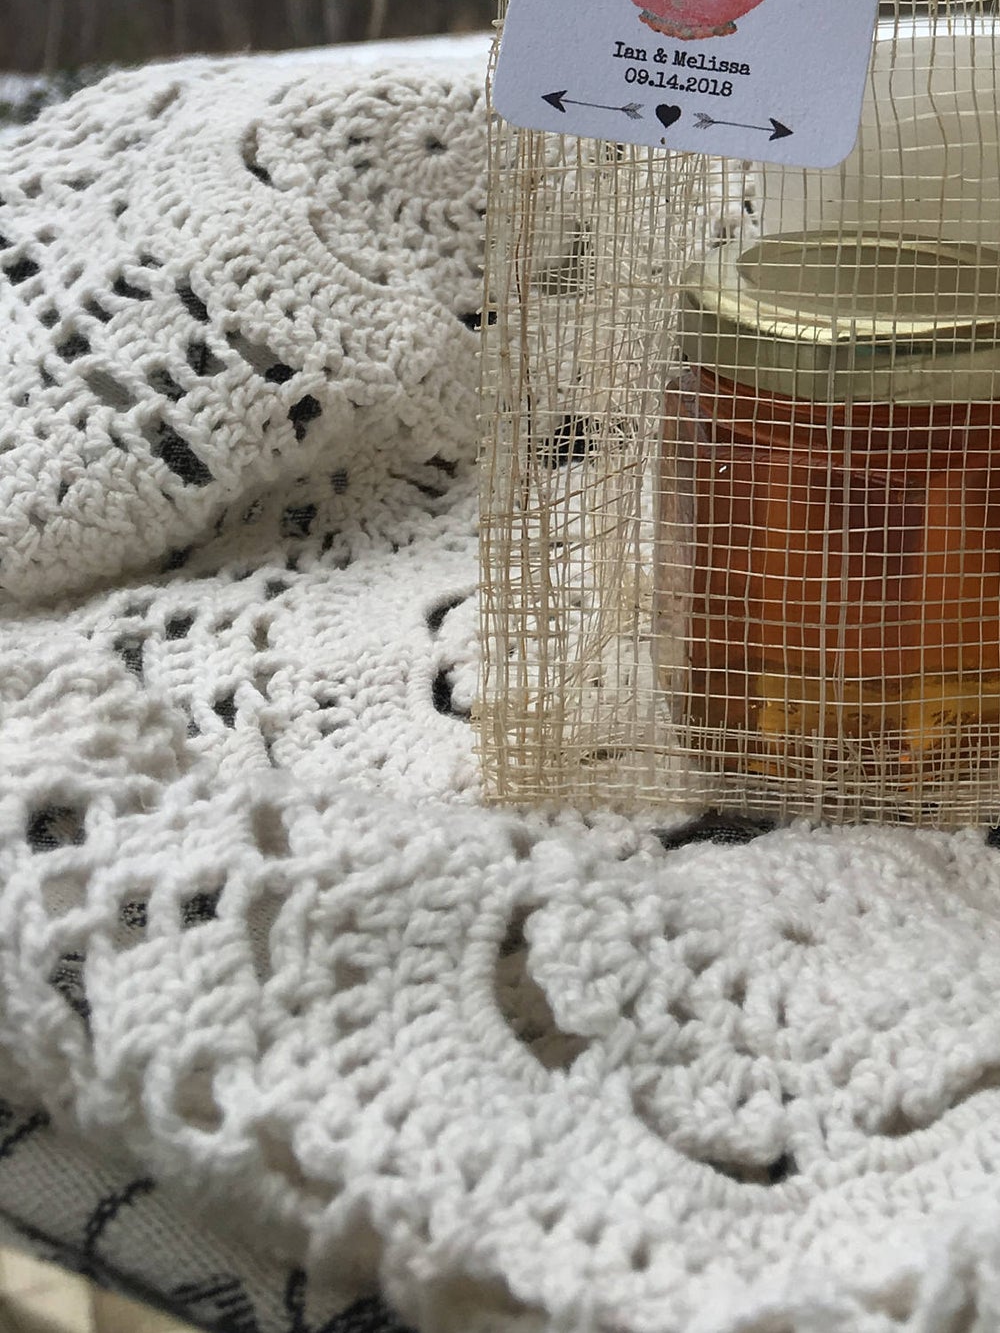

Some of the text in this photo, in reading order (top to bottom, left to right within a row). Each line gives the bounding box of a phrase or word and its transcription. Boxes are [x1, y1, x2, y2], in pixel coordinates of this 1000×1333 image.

[612, 40, 751, 76] Ian & Melissa
[624, 66, 734, 98] 09.14.2018
